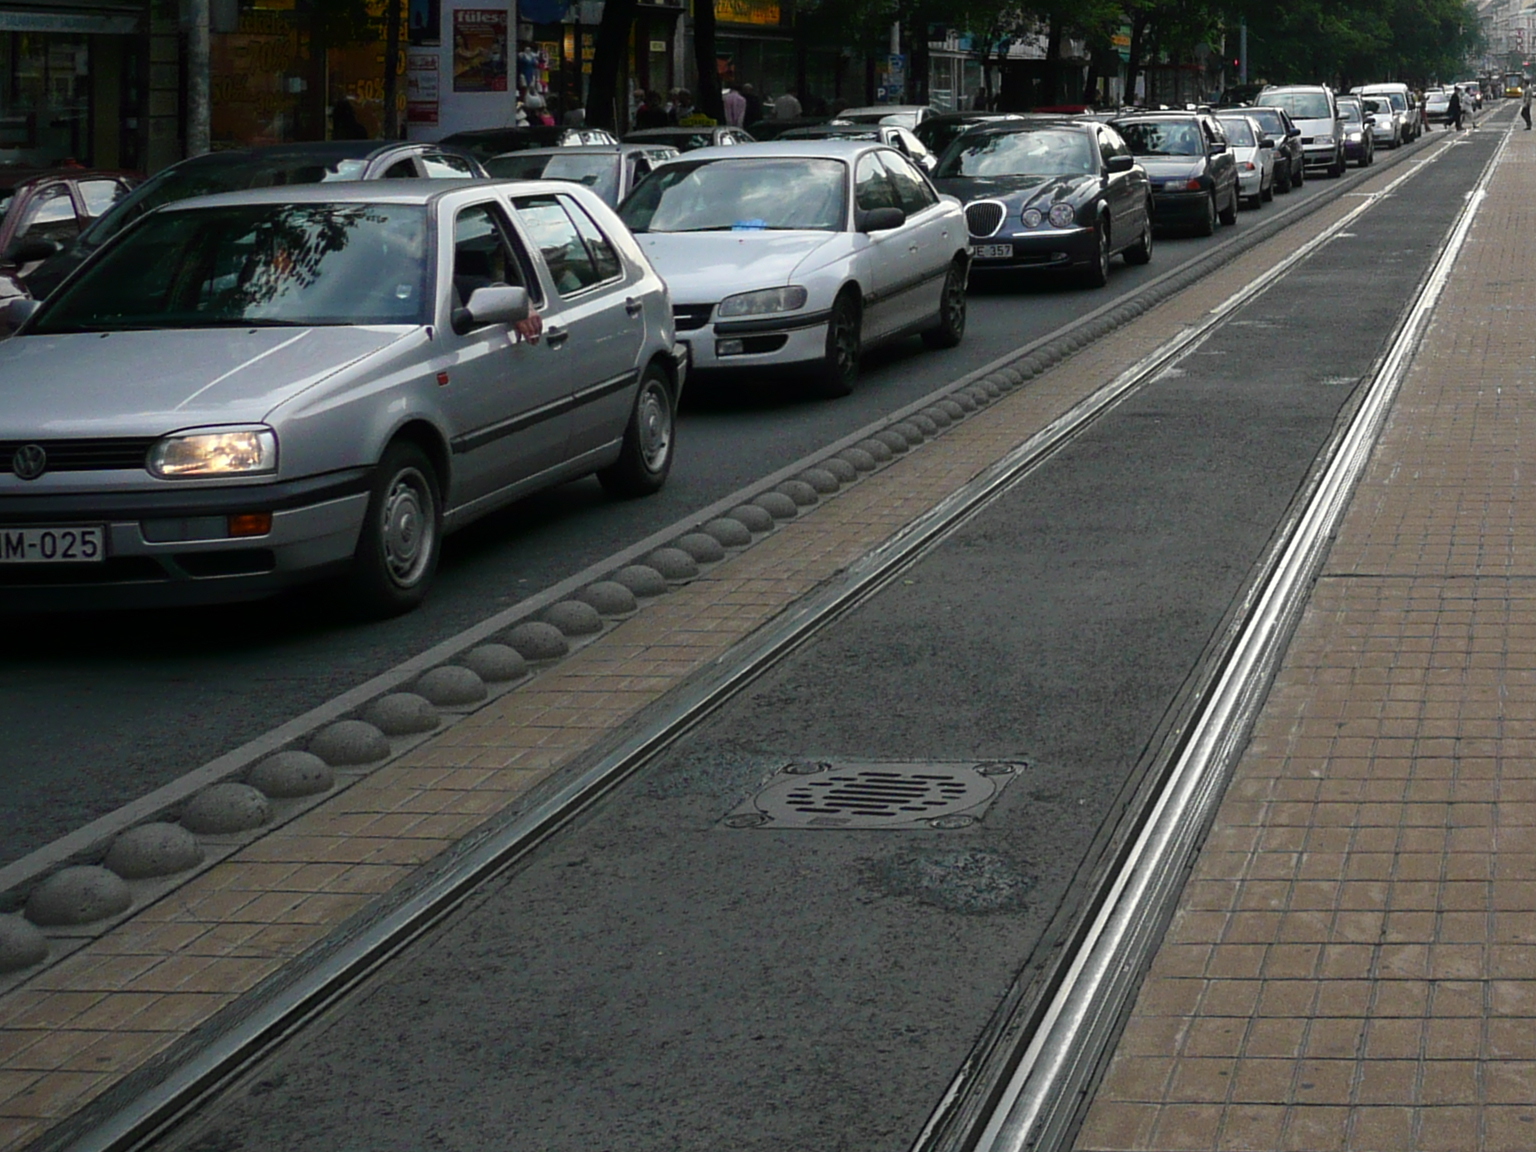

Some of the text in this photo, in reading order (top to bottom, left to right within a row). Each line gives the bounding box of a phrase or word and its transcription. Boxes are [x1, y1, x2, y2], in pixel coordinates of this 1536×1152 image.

[457, 11, 499, 23] füles
[877, 87, 886, 99] P
[0, 530, 97, 559] M-025
